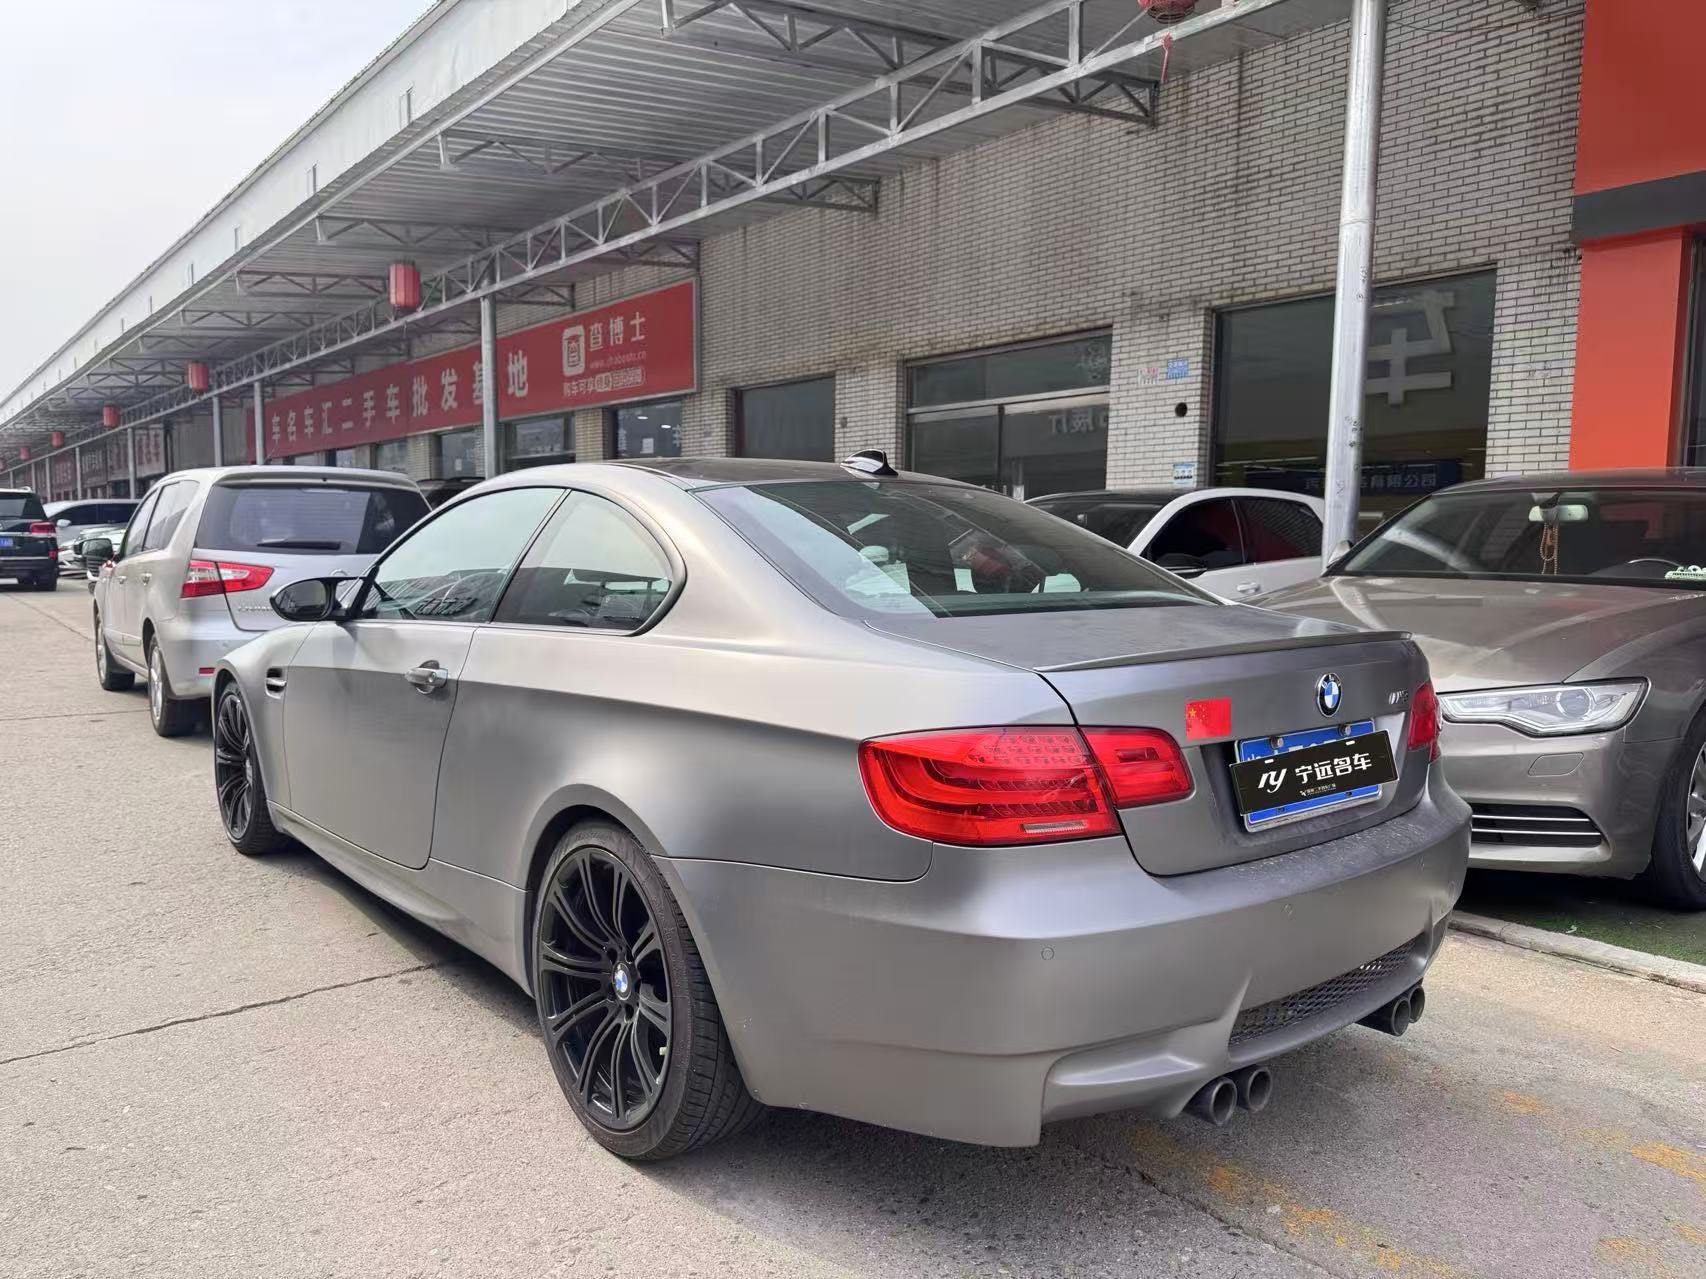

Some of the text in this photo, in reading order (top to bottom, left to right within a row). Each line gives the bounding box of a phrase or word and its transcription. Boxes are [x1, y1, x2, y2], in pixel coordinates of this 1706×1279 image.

[589, 311, 647, 352] 查博士
[1294, 752, 1373, 784] 宁远名车
